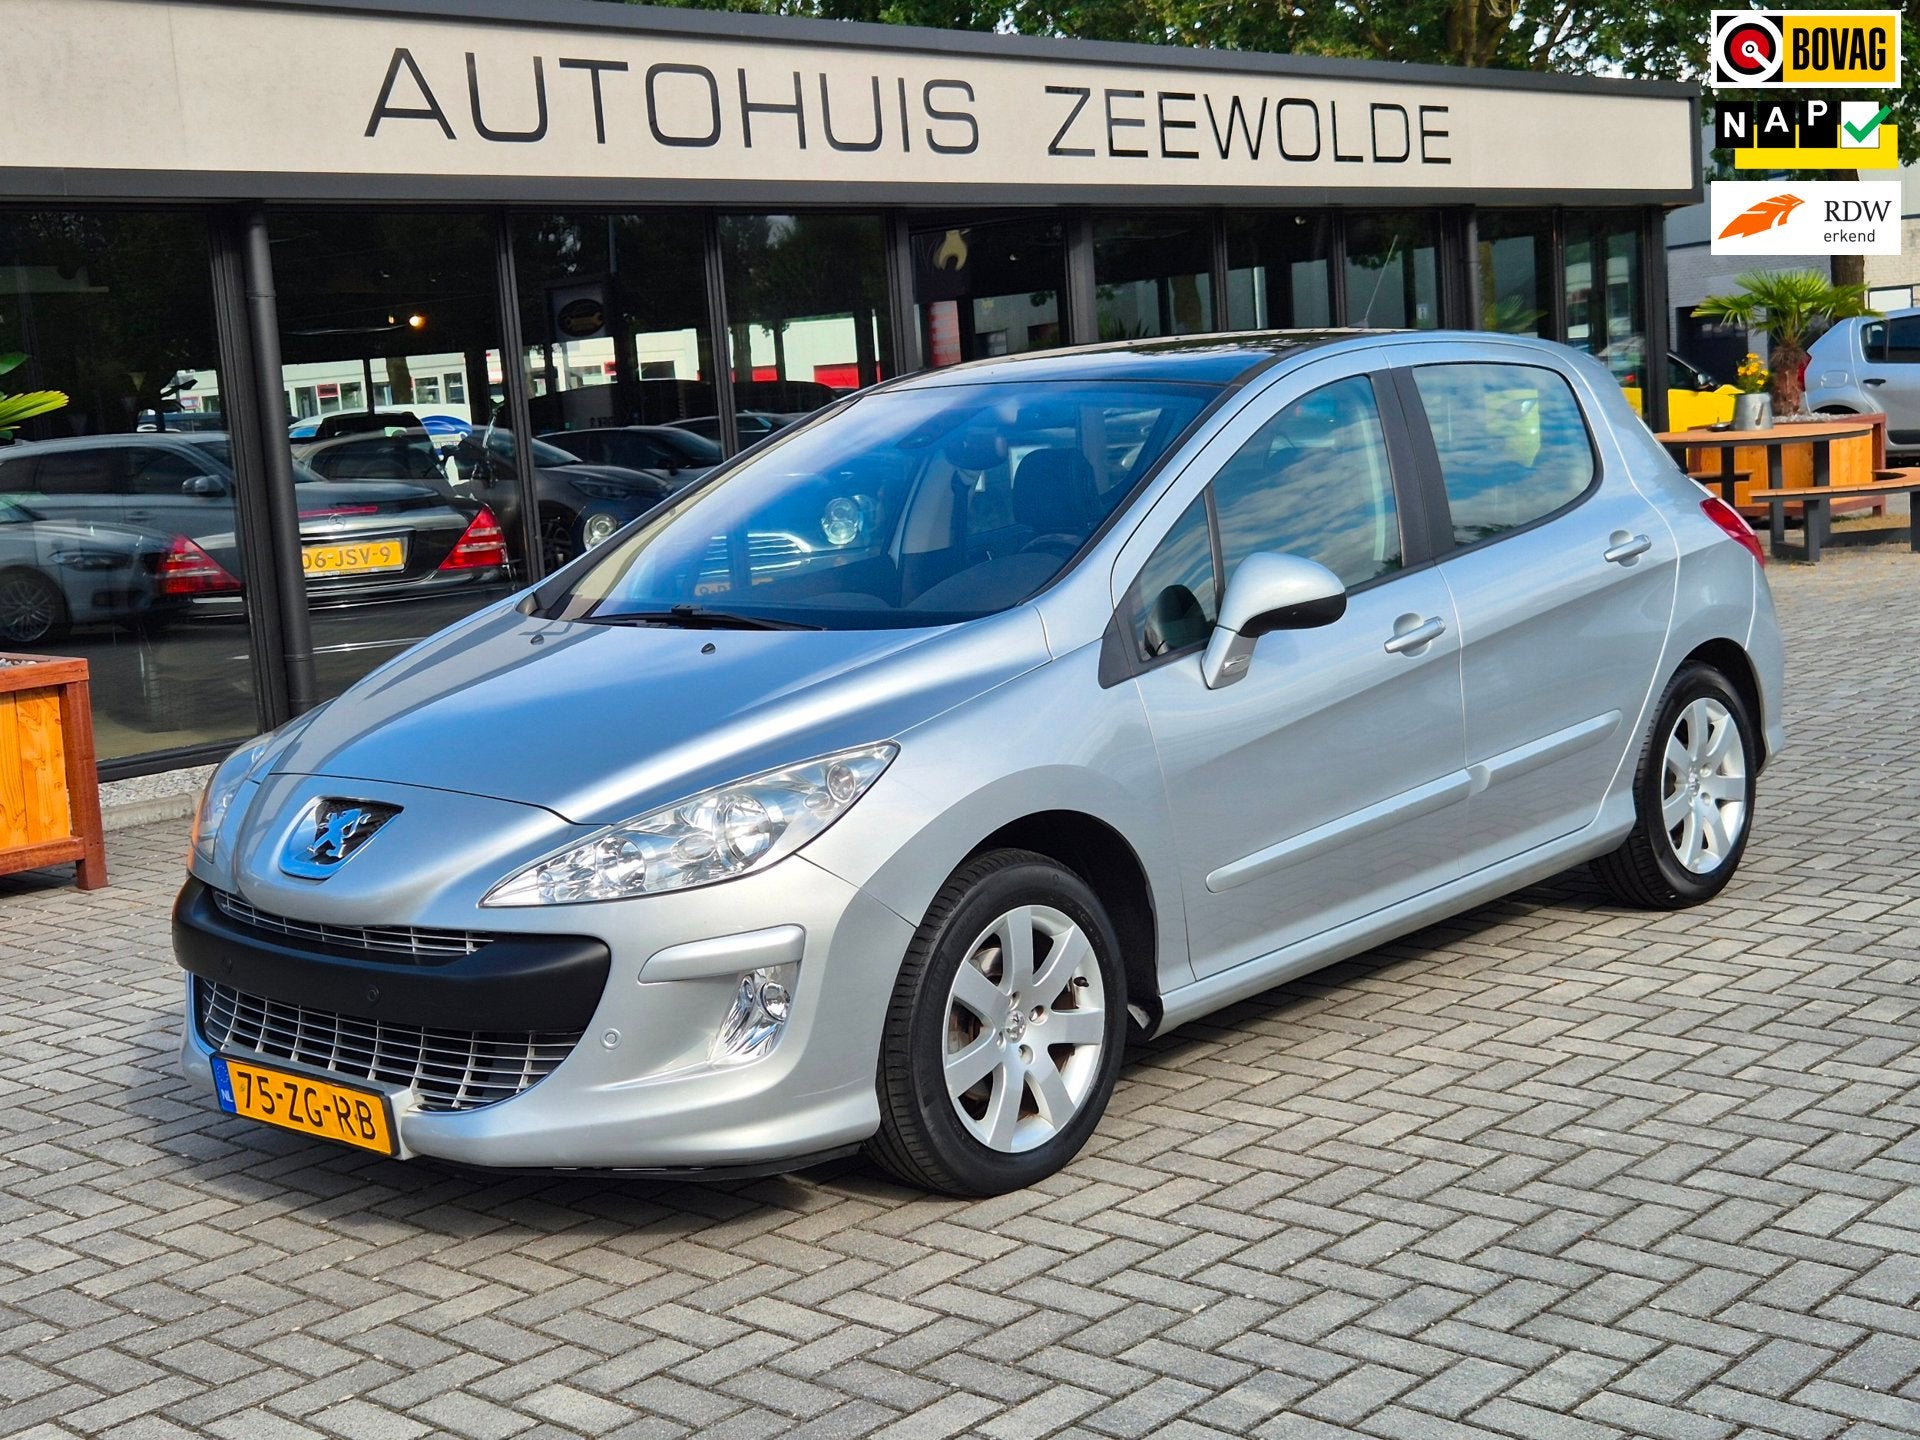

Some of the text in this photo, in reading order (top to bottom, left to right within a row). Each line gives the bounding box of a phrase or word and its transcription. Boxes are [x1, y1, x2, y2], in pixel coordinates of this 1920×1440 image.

[363, 47, 1452, 164] AUTOHUIS ZEEWOLDE
[221, 1088, 234, 1103] NL
[237, 1071, 376, 1140] 75-ZG-RB
